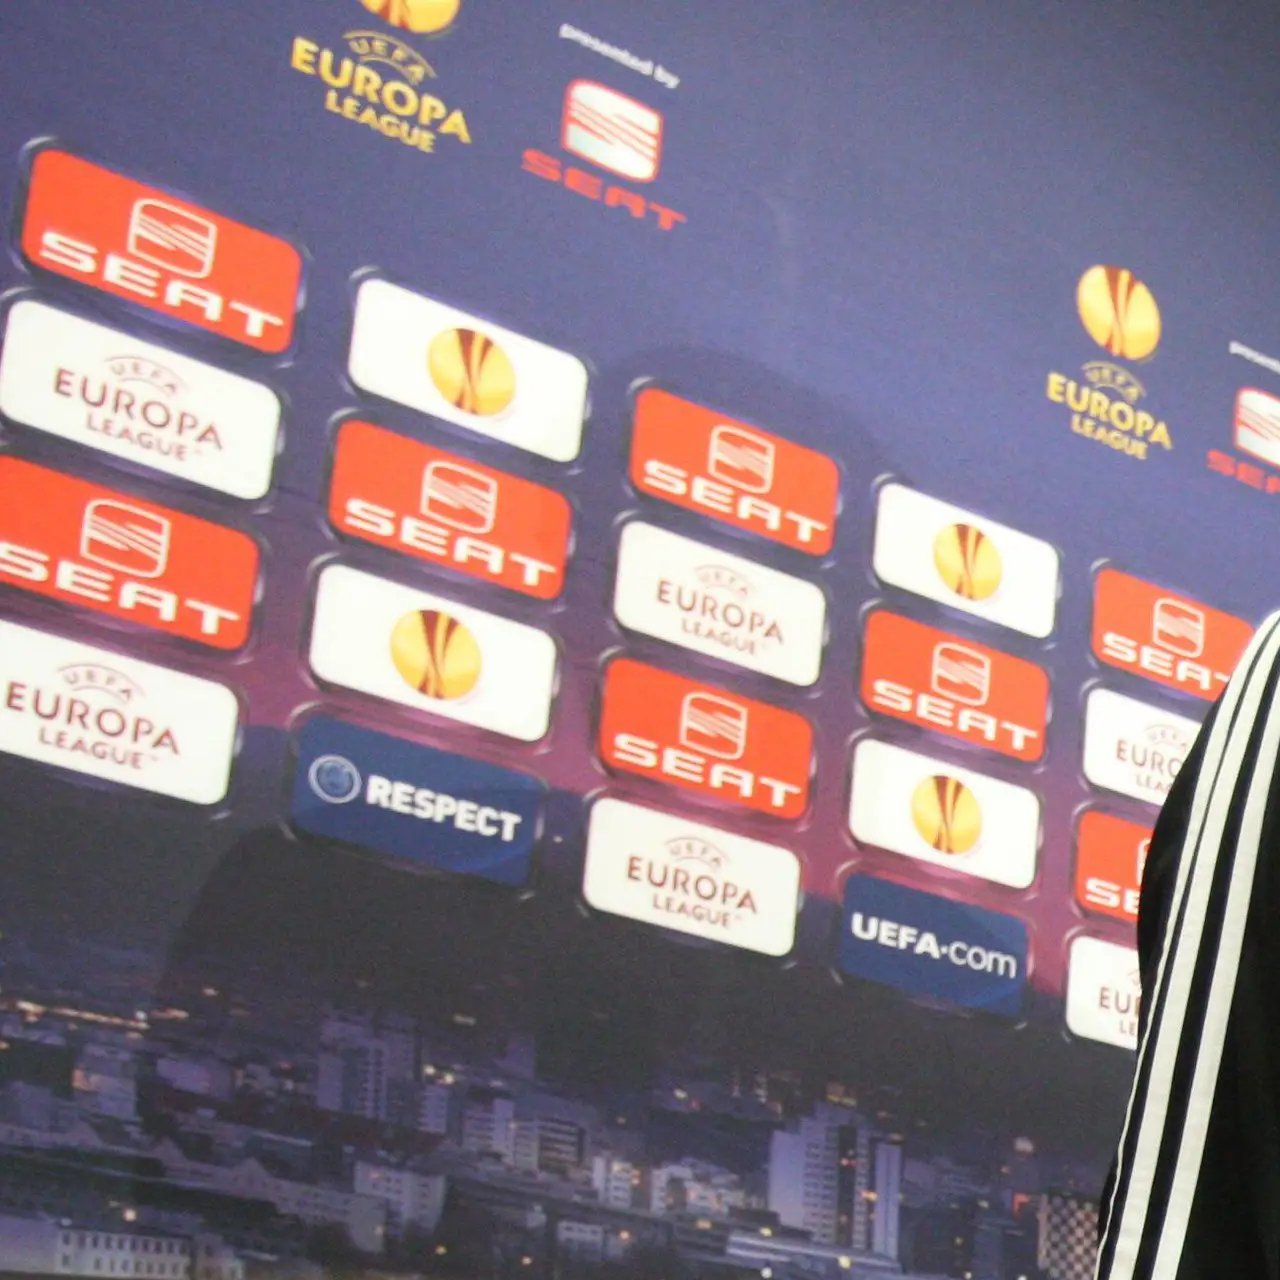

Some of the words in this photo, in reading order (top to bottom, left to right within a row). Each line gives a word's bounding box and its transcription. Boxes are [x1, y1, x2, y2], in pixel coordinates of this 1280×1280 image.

[348, 37, 425, 85] UEFA
[559, 23, 653, 76] presented
[654, 65, 681, 89] by
[290, 36, 472, 145] EUROPA
[325, 90, 437, 153] LEAGUE
[522, 148, 688, 231] SEAT
[41, 231, 284, 337] SEAT
[54, 367, 225, 451] EUROPA
[111, 357, 180, 397] UEFA
[86, 411, 190, 462] LEAGUE
[1047, 371, 1174, 451] EUROPA
[1071, 414, 1148, 461] LEAGUE
[644, 459, 828, 543] SEAT
[345, 497, 557, 587] SEAT
[0, 541, 240, 635] SEAT
[656, 580, 786, 645] EUROPA
[681, 617, 762, 658] LEAGUE
[8, 680, 181, 756] EUROPA
[63, 670, 135, 702] UEFA
[873, 679, 1040, 754] SEAT
[38, 726, 143, 770] LEAGUE
[614, 732, 802, 809] SEAT
[1116, 737, 1183, 779] EURO
[366, 774, 522, 842] RESPECT
[626, 855, 759, 916] EUROPA
[668, 839, 724, 869] UEFA
[652, 894, 731, 930] LEAGUE
